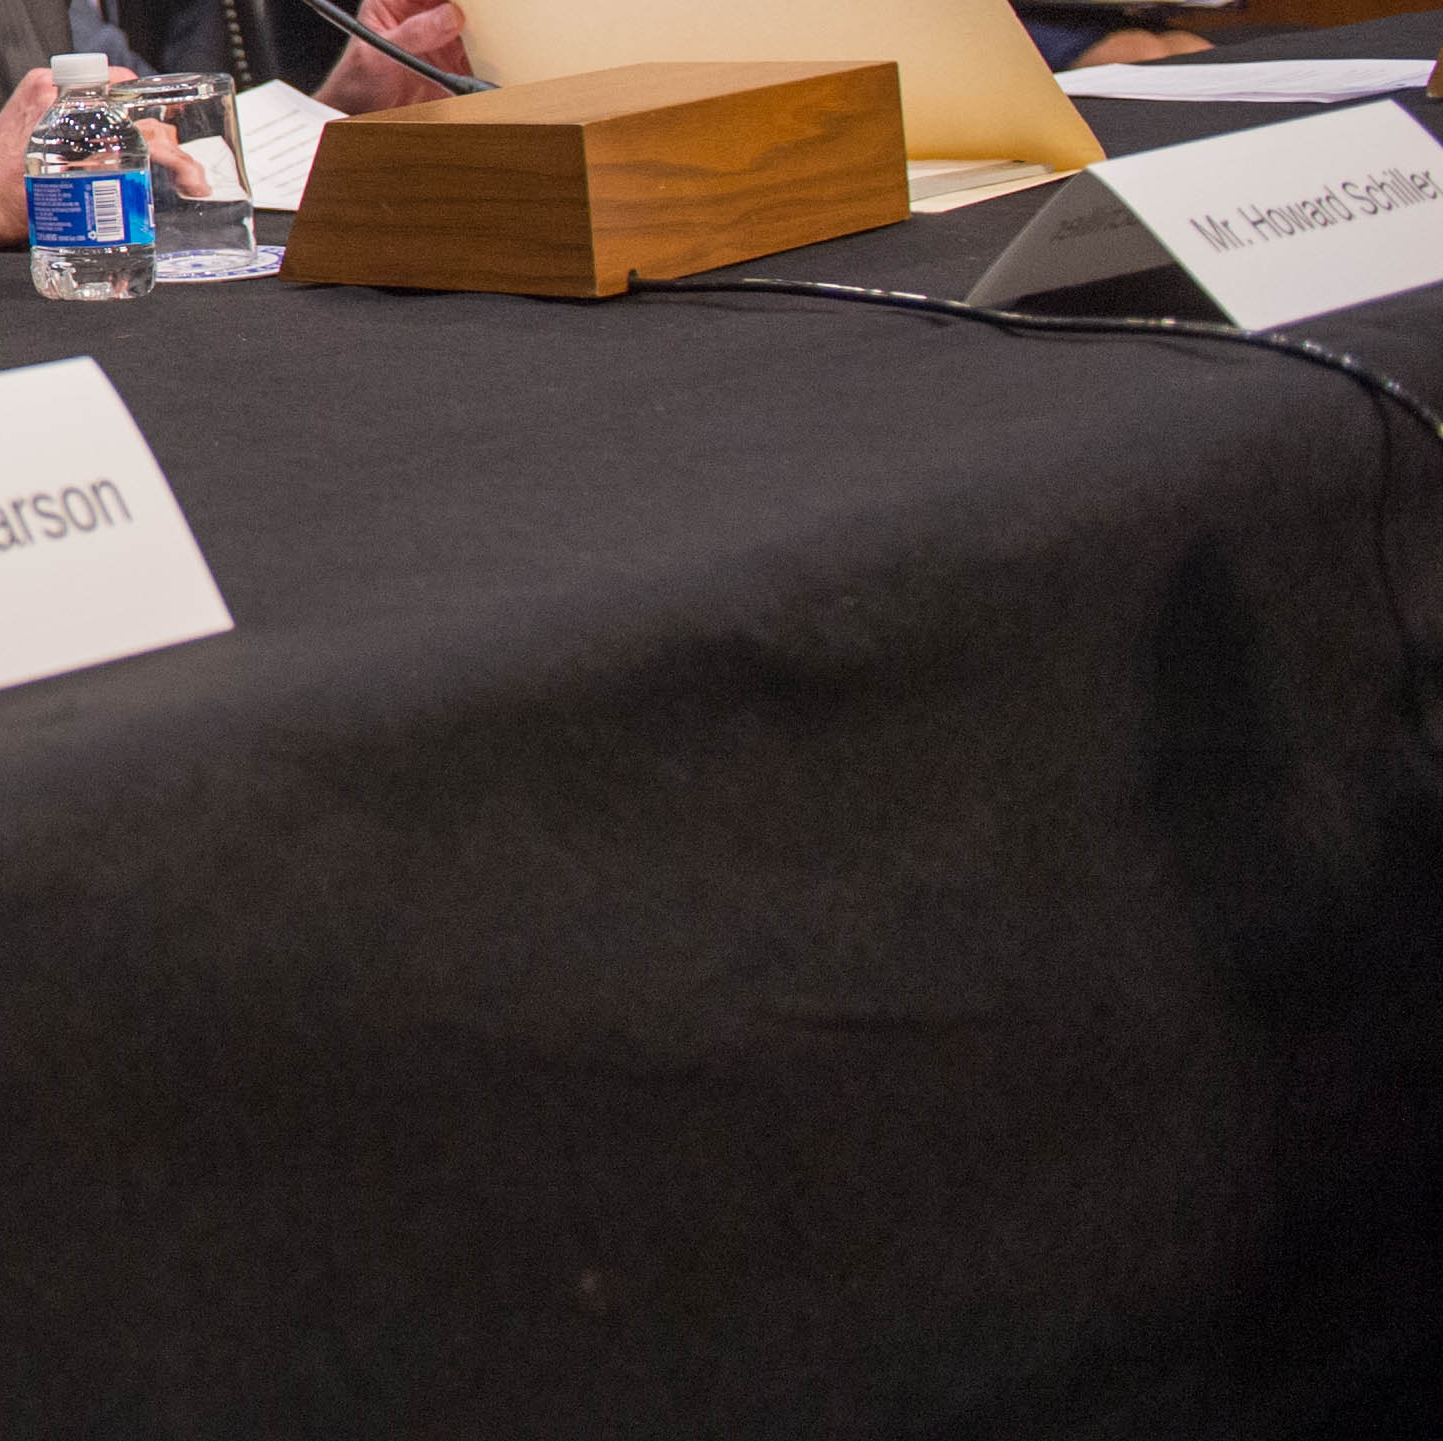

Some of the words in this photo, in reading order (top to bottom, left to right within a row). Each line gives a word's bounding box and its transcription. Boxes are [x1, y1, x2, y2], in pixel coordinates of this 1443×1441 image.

[1188, 212, 1255, 254] Mr.
[1236, 184, 1355, 241] Howard
[1340, 166, 1443, 216] Schiller
